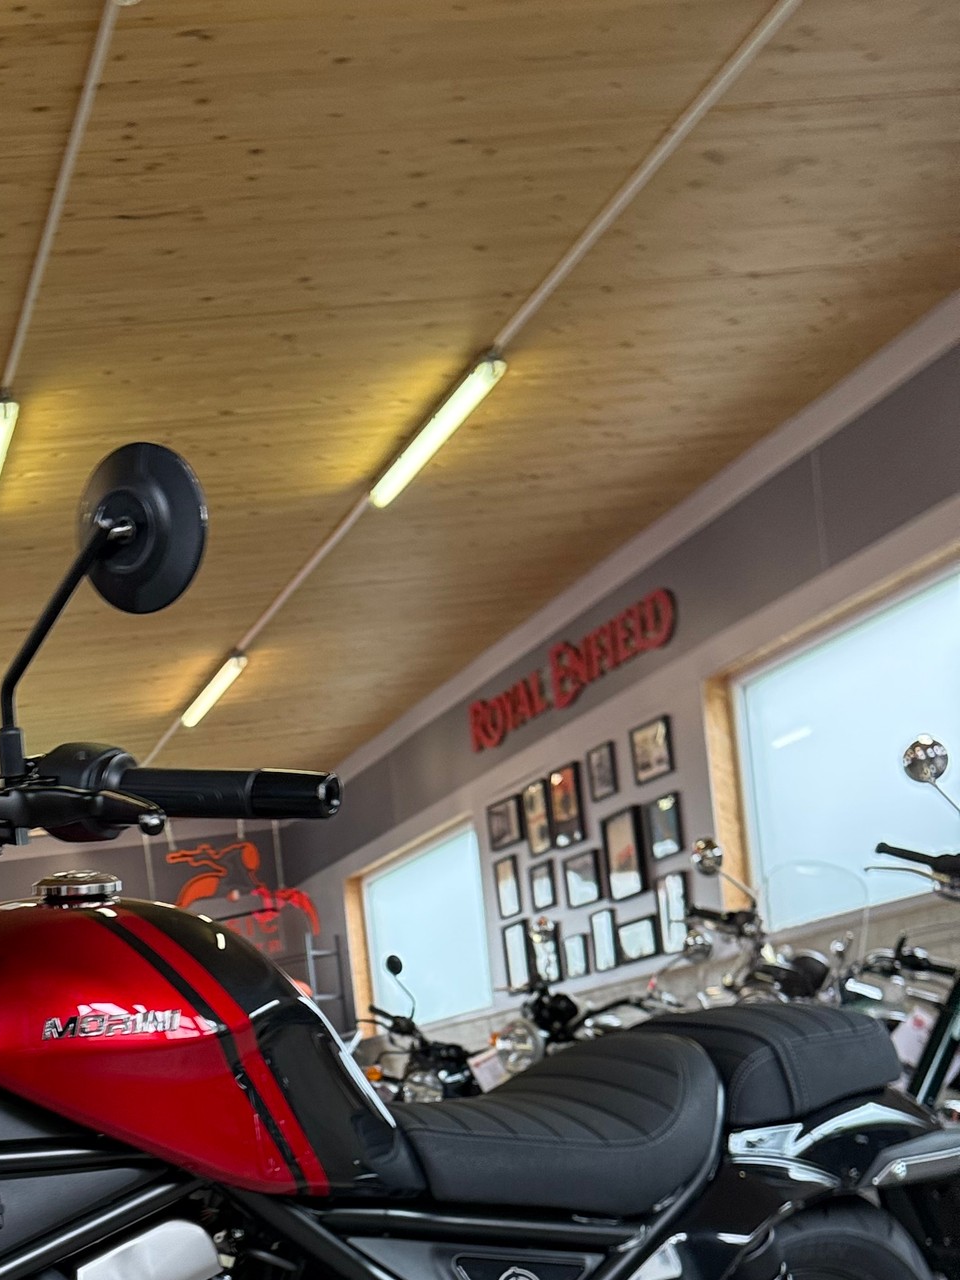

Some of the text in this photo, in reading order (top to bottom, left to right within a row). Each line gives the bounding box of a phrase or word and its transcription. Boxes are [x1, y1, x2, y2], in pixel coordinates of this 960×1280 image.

[469, 587, 676, 753] ROYAL ENFIELD
[42, 1009, 181, 1041] MORINI
